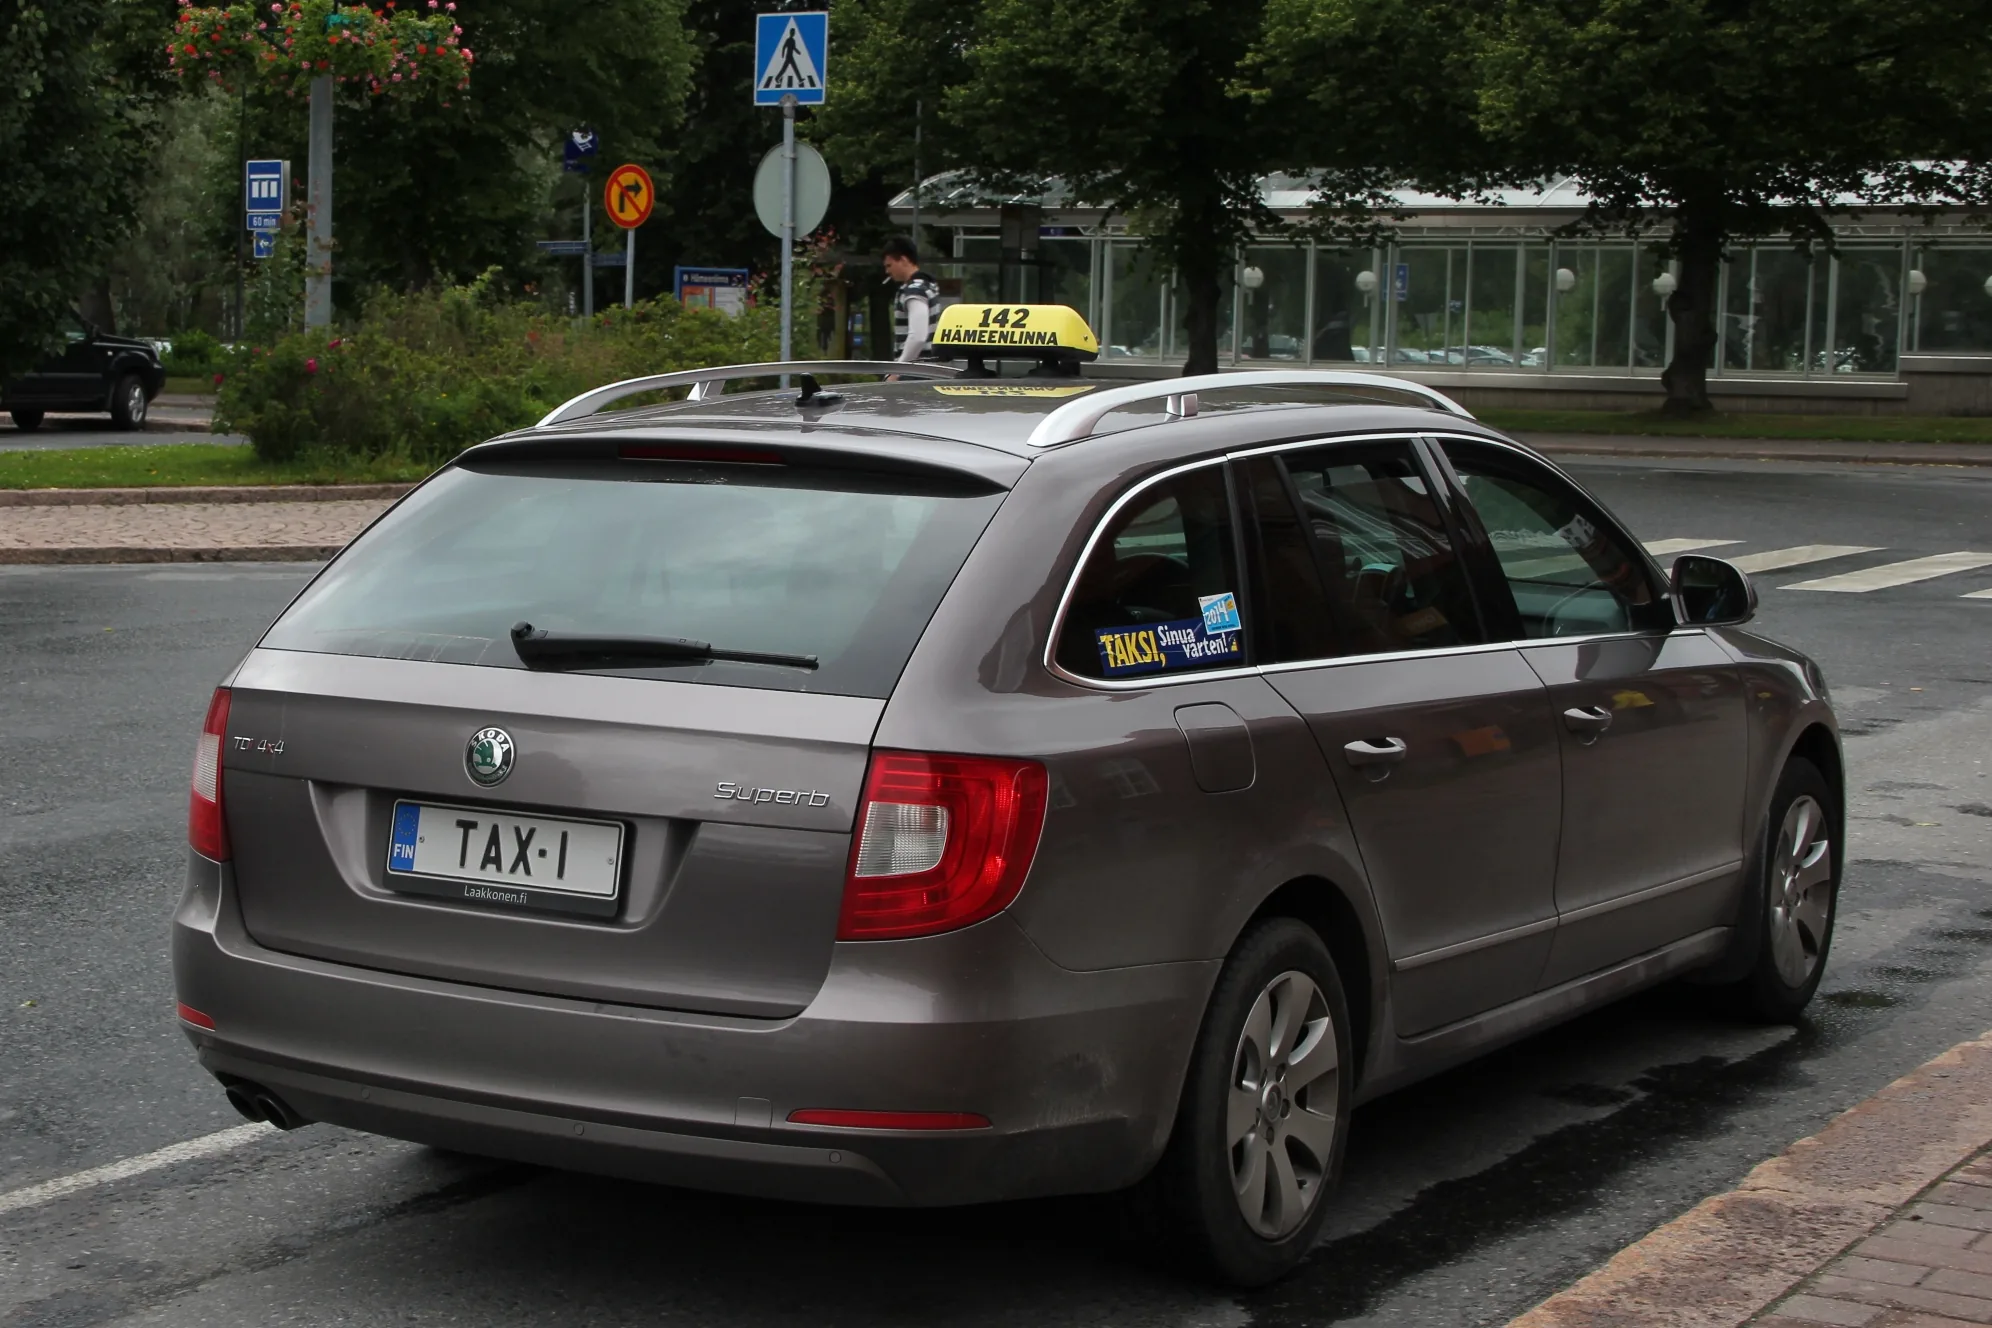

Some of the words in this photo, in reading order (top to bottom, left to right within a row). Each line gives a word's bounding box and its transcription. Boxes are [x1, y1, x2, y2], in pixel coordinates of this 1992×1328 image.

[252, 217, 262, 227] 60
[263, 216, 276, 226] min
[978, 308, 1030, 329] 142
[940, 324, 1059, 346] HÄMEENLINNA
[1203, 600, 1230, 625] 2014
[1099, 630, 1166, 668] TAKSI,
[1157, 625, 1196, 647] Sinua
[1182, 632, 1229, 659] varten!
[257, 739, 285, 755] 4x4
[713, 781, 830, 807] Superb
[393, 843, 414, 859] FIN
[463, 885, 528, 904] Laakkonen.fi
